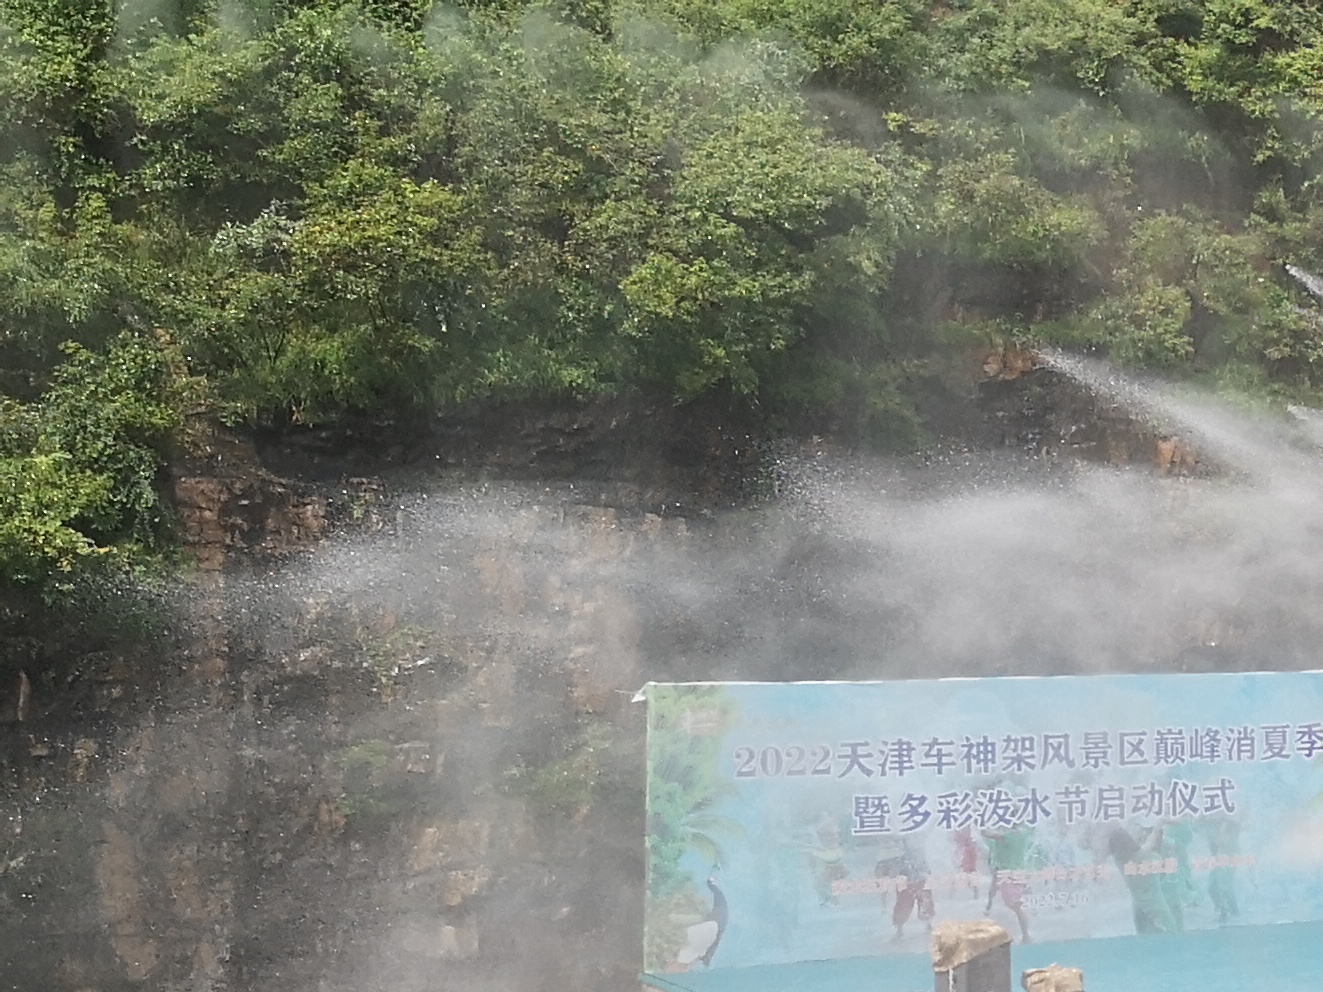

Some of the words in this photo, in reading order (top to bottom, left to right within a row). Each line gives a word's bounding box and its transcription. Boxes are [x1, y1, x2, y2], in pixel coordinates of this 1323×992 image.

[852, 778, 1236, 834] 暨多彩泼水节启动仪式
